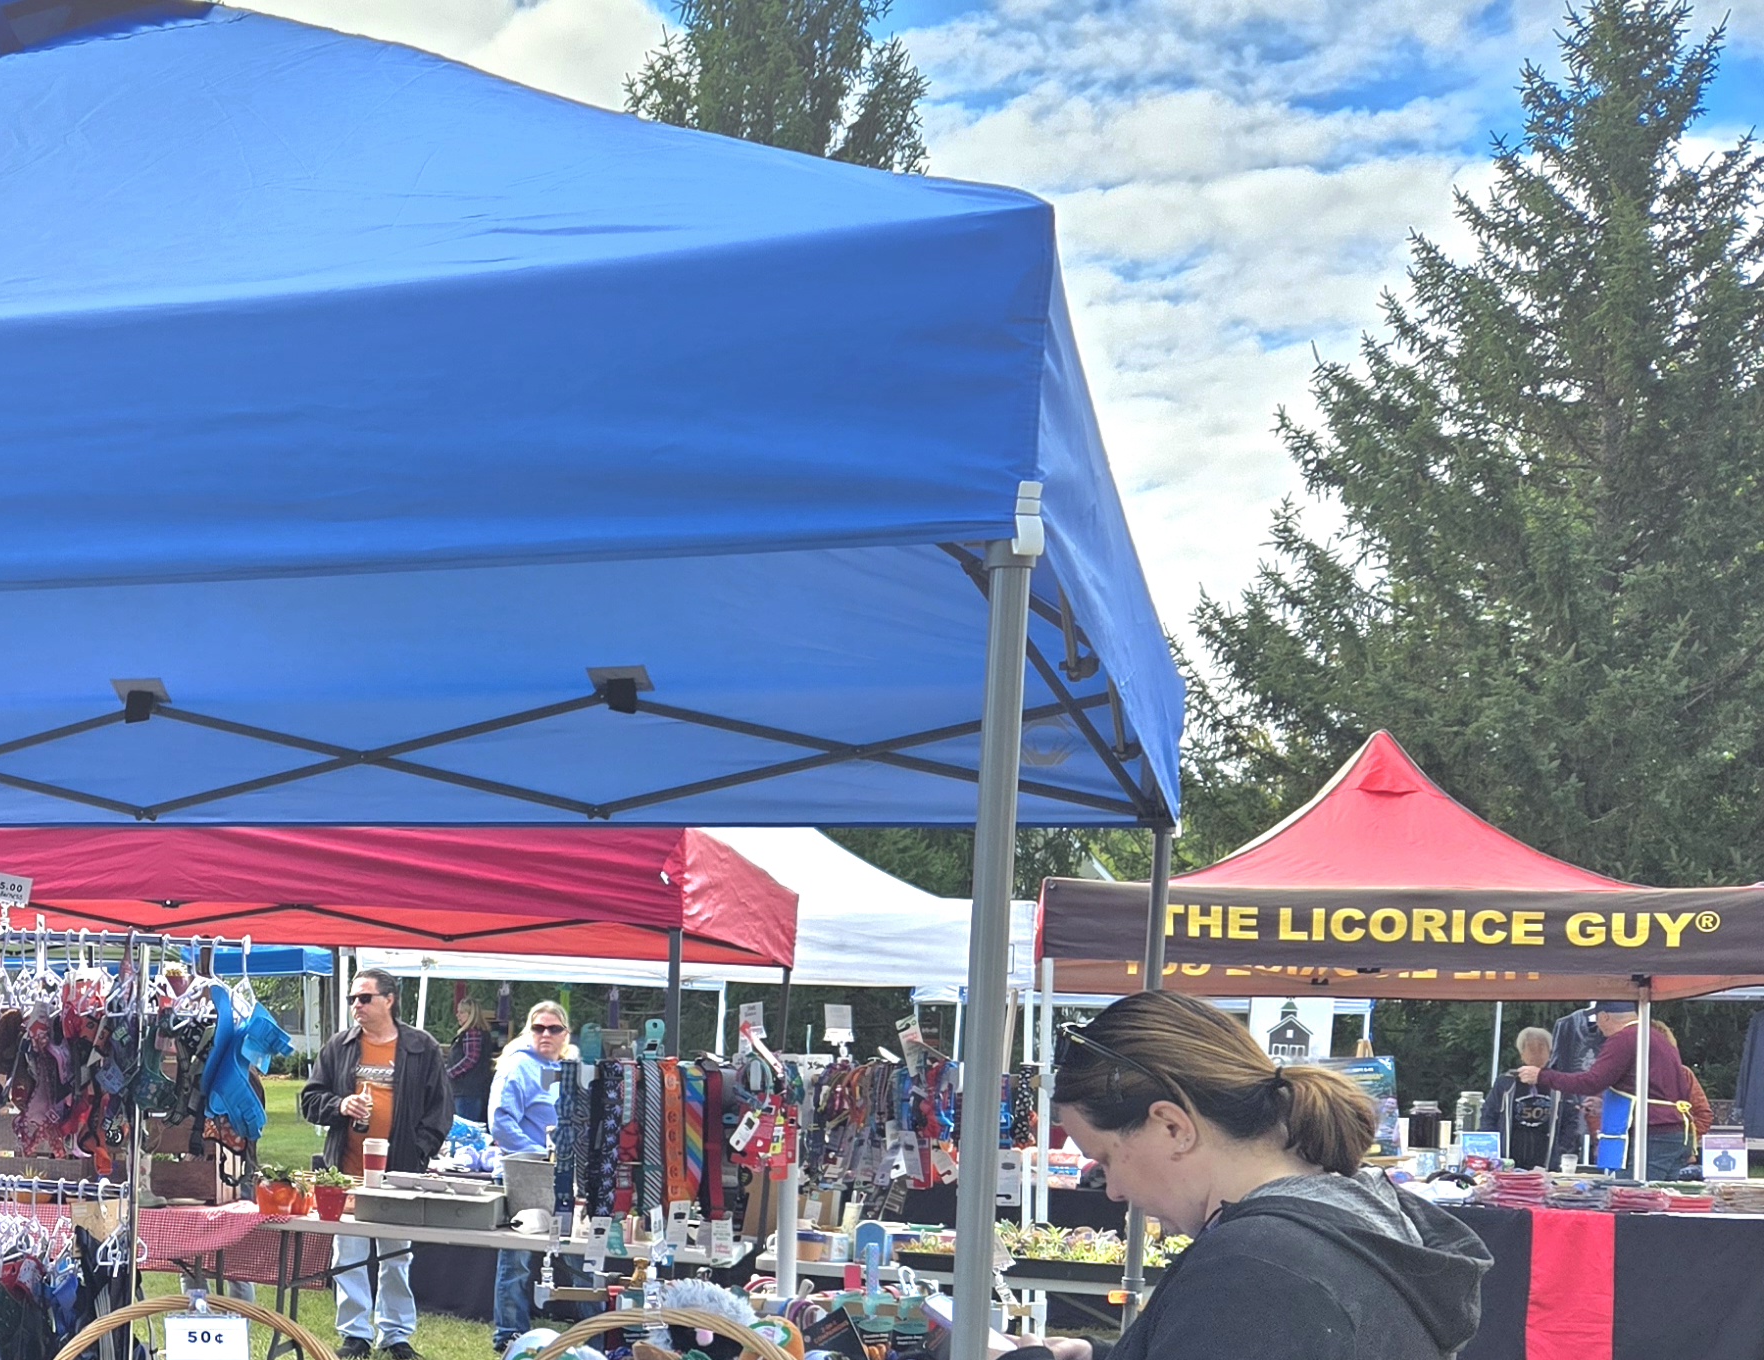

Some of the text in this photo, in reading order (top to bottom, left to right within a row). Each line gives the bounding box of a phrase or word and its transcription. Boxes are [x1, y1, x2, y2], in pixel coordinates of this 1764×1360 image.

[1163, 904, 1259, 940] THE
[1278, 907, 1546, 946] LICORICE
[187, 1330, 224, 1345] 50¢
